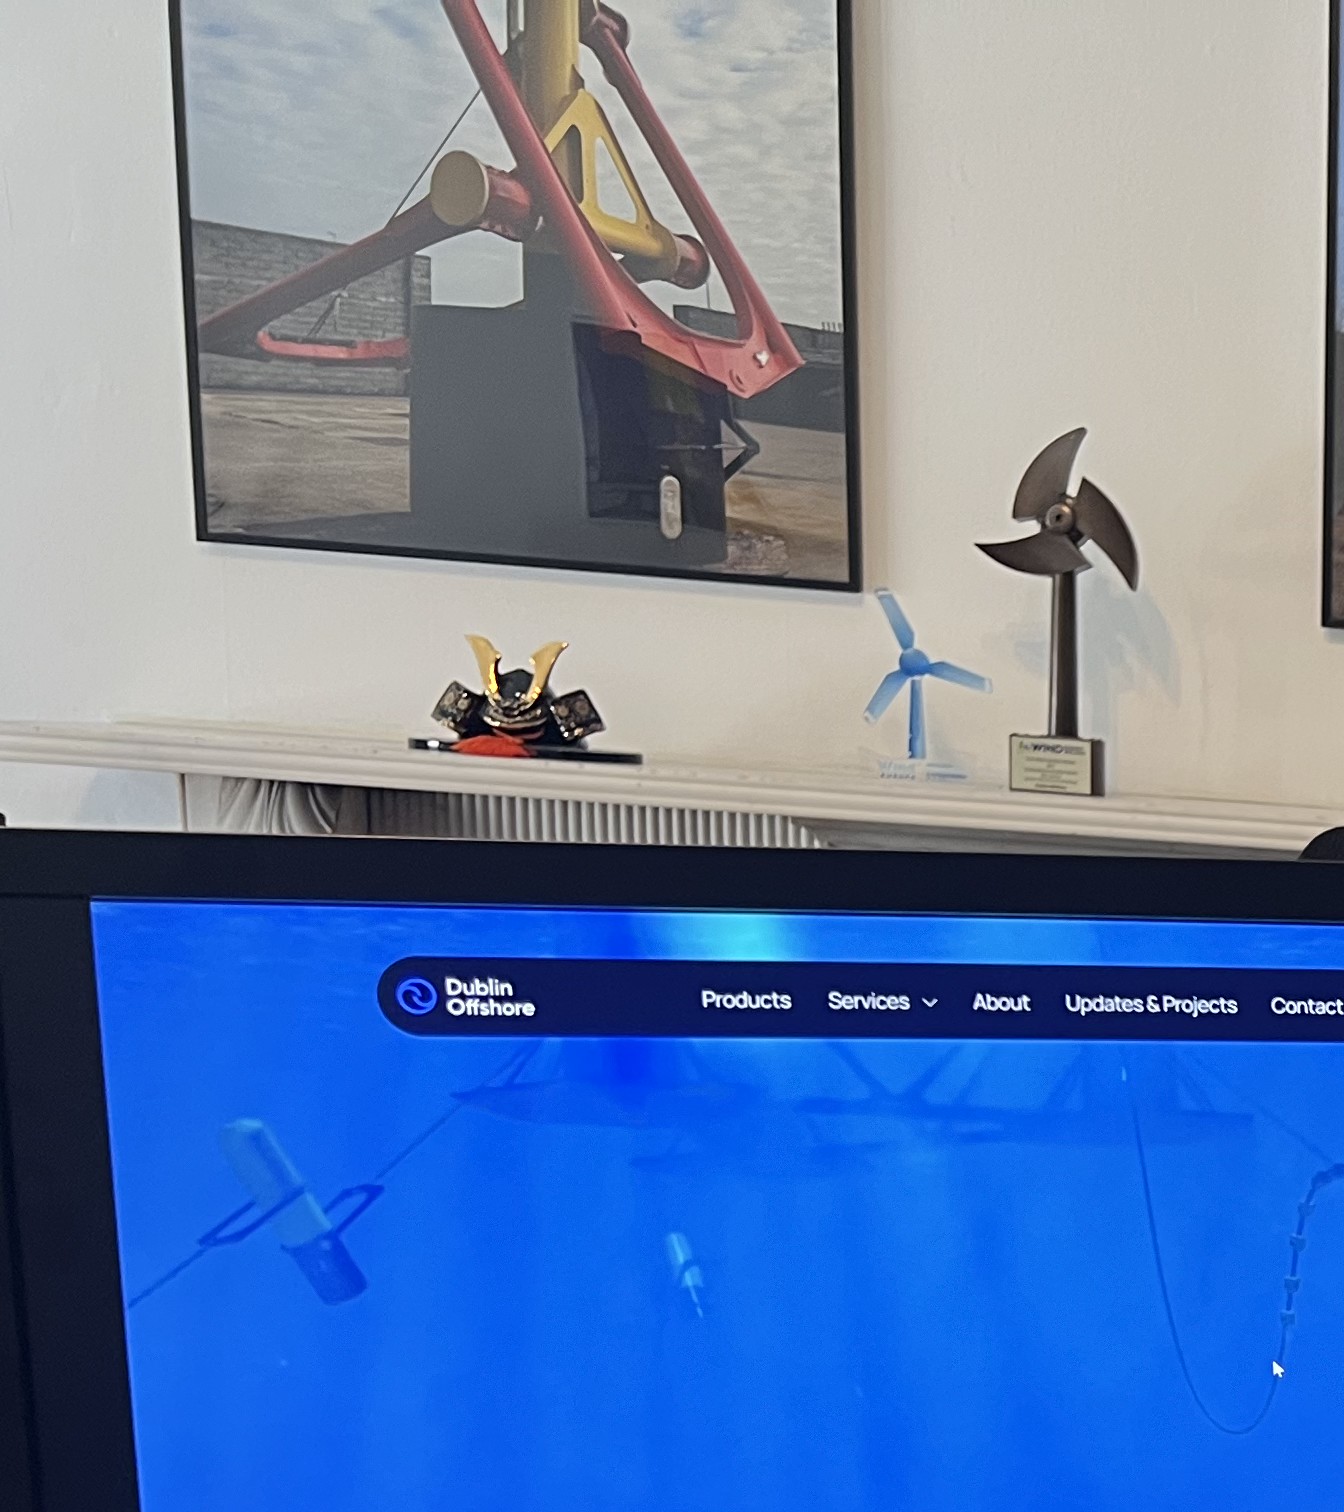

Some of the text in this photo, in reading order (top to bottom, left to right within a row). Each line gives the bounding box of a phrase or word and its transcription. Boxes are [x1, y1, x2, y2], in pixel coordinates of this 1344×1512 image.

[444, 976, 514, 996] Dublin
[445, 998, 536, 1017] Offshore
[701, 989, 793, 1010] Products
[828, 990, 911, 1011] Services
[972, 992, 1032, 1012] About
[1064, 993, 1239, 1018] Updates & Projects
[1270, 996, 1344, 1016] Contact
